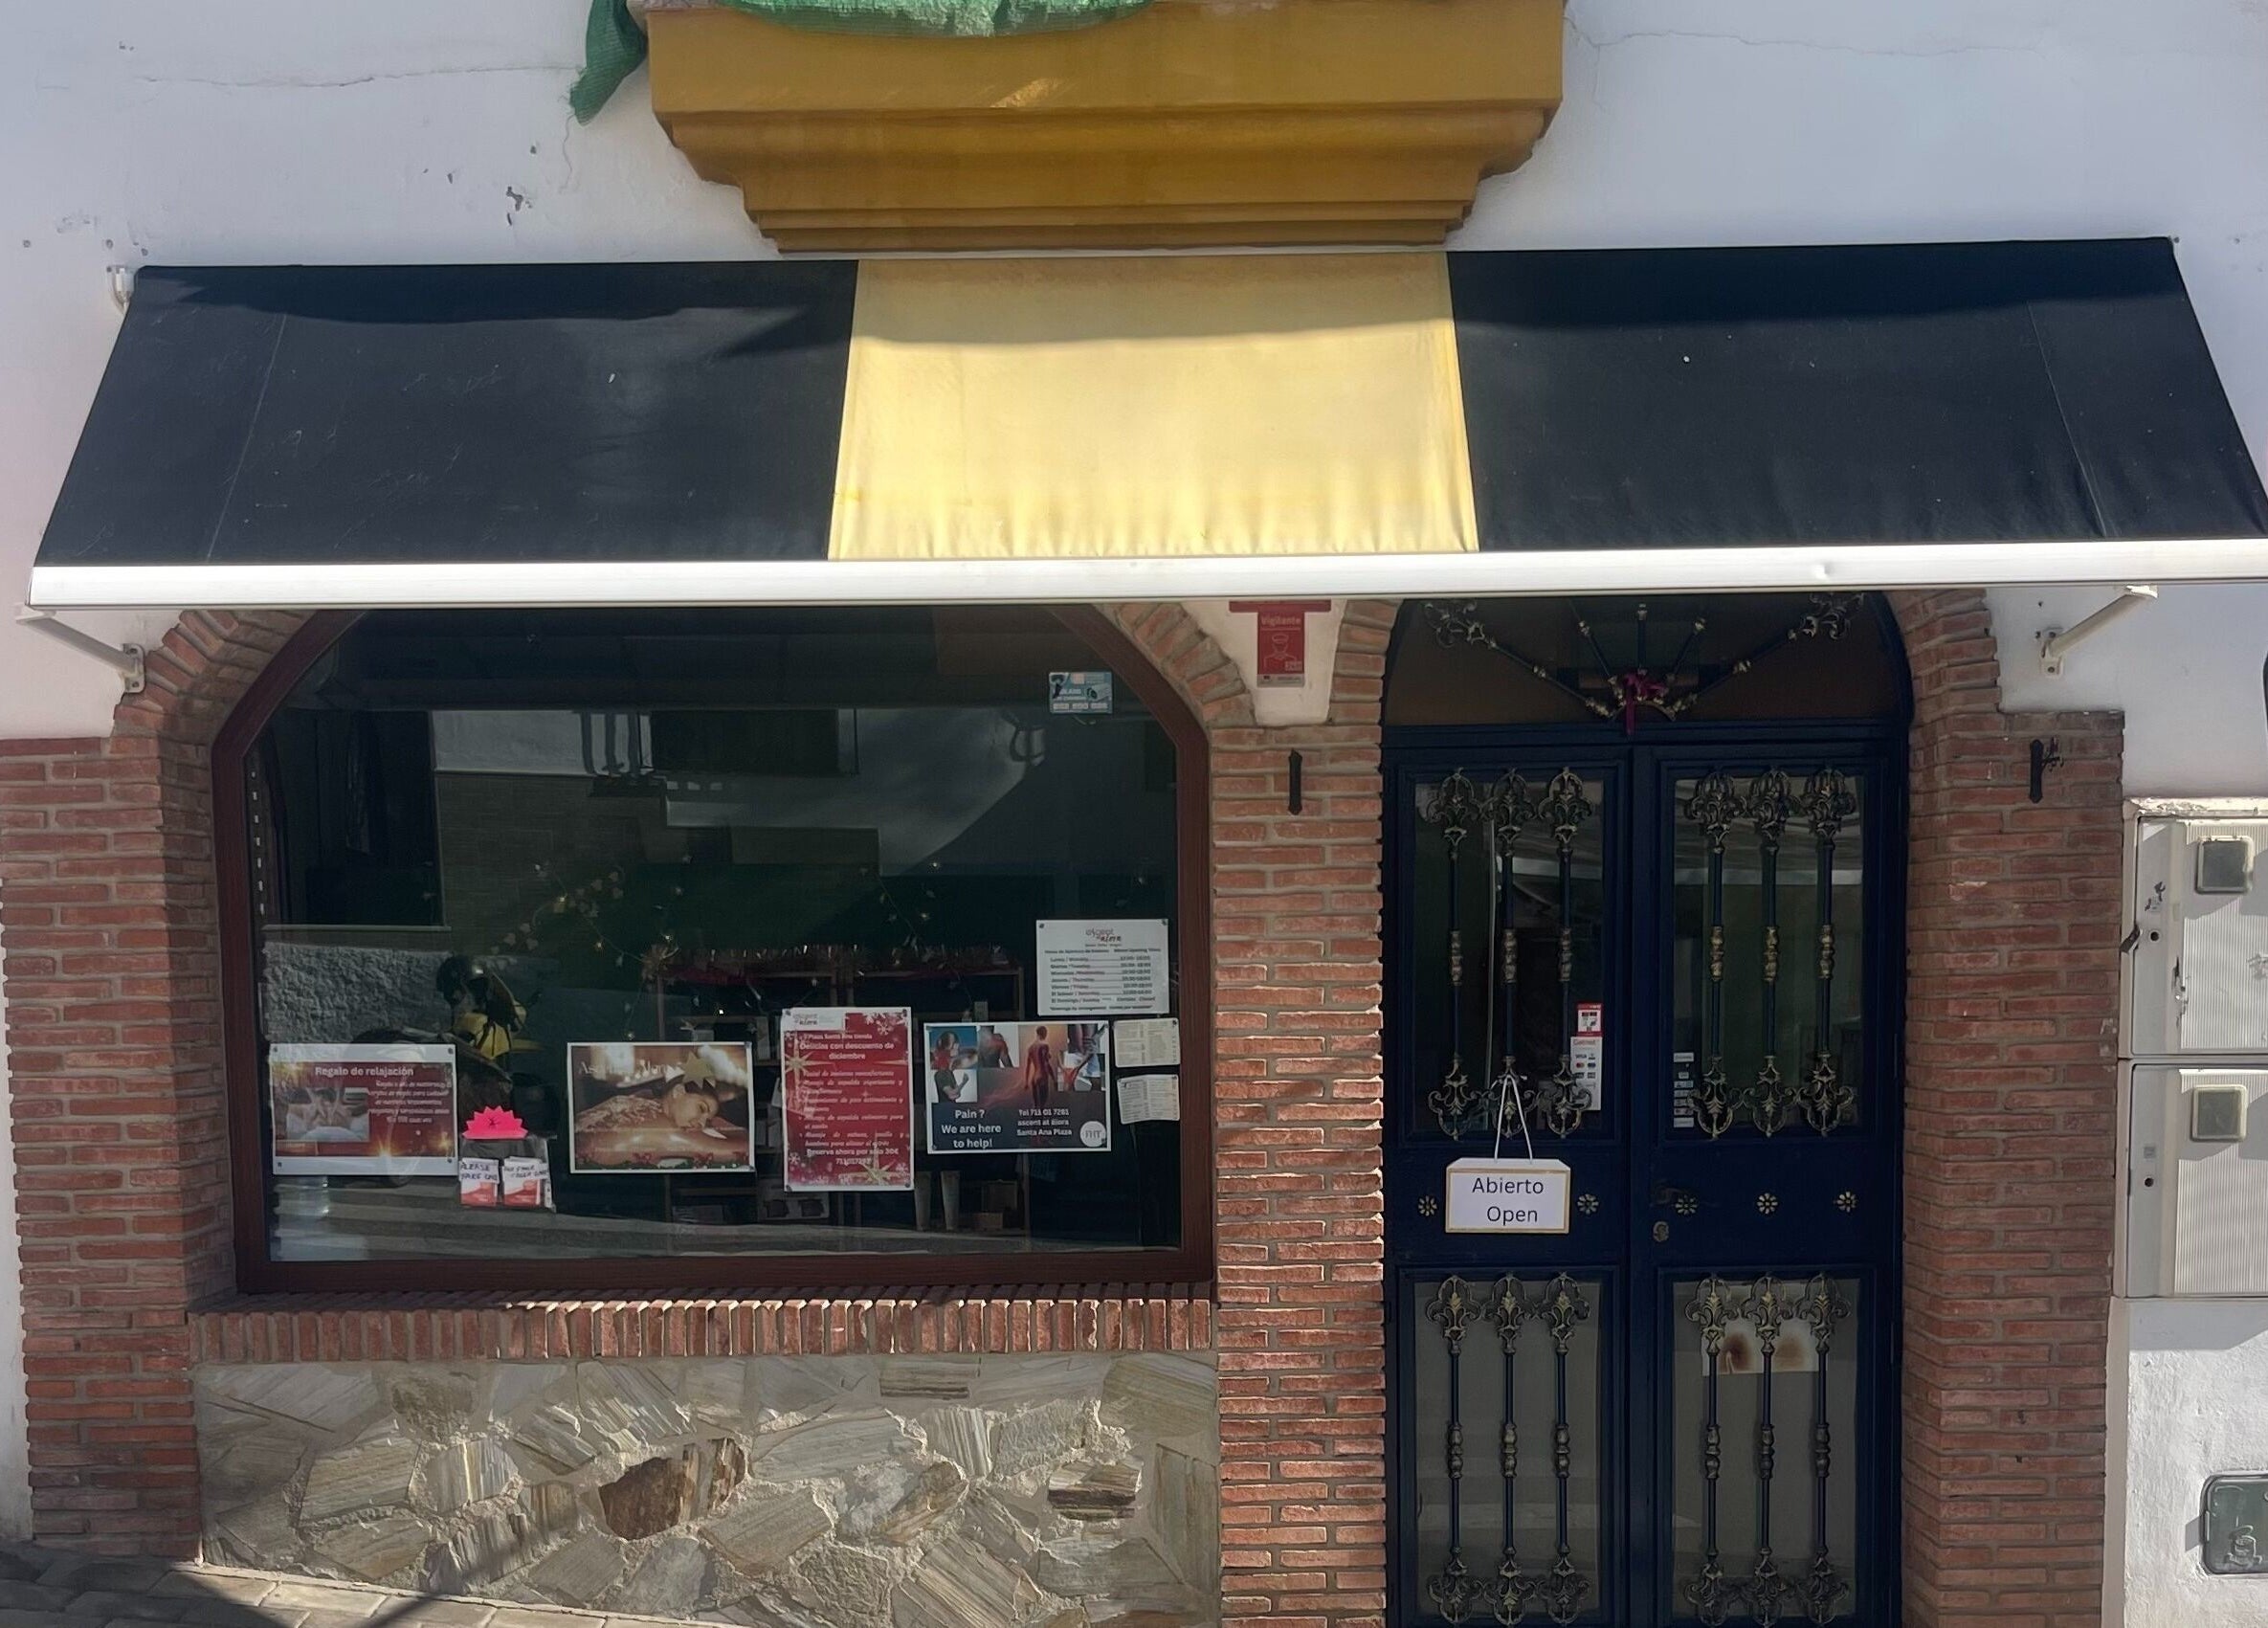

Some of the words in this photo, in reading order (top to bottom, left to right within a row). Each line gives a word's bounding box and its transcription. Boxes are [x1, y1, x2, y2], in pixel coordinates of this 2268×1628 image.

[315, 1066, 349, 1078] Regalo
[350, 1066, 364, 1076] de
[365, 1065, 414, 1078] relajación
[954, 1108, 977, 1119] Pain
[941, 1124, 957, 1134] We
[959, 1126, 976, 1134] are
[978, 1123, 1002, 1133] here
[953, 1139, 965, 1149] to
[967, 1138, 992, 1149] help!
[1472, 1176, 1545, 1194] Abierto
[1486, 1205, 1538, 1226] Open
